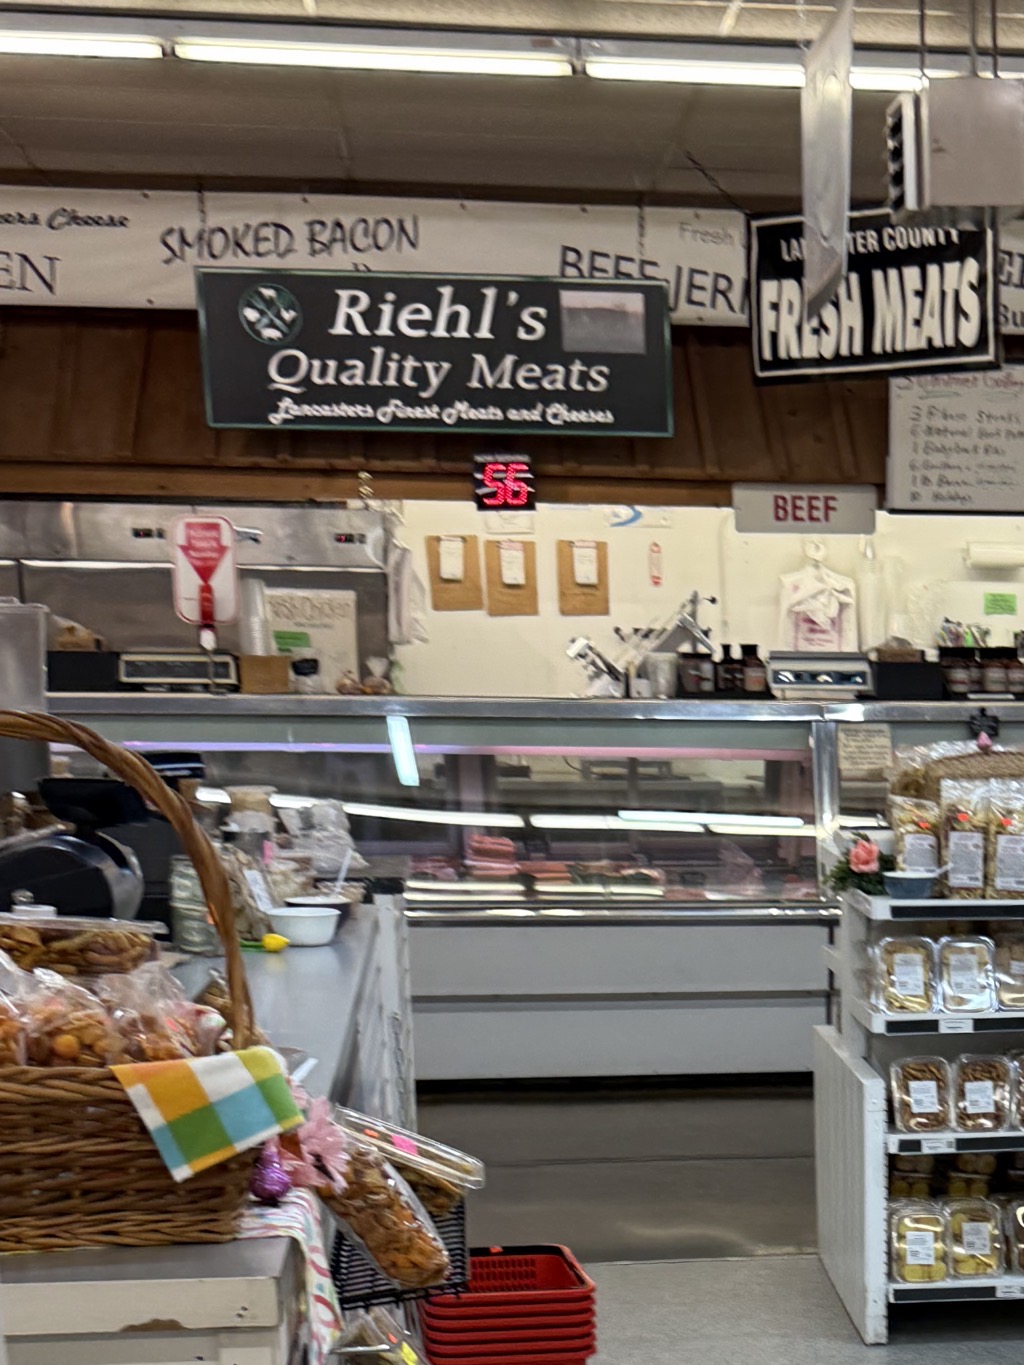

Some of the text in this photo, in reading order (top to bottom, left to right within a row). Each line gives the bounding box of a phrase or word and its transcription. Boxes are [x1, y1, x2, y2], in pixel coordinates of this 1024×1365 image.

[160, 215, 420, 265] SMOKED BACON
[0, 252, 61, 295] EN
[668, 265, 749, 318] JER
[327, 285, 547, 342] Riehl's
[872, 256, 980, 354] MEATS
[267, 346, 610, 399] Quality Meats
[506, 404, 543, 423] and
[482, 463, 530, 506] 56
[774, 495, 838, 523] BEEF
